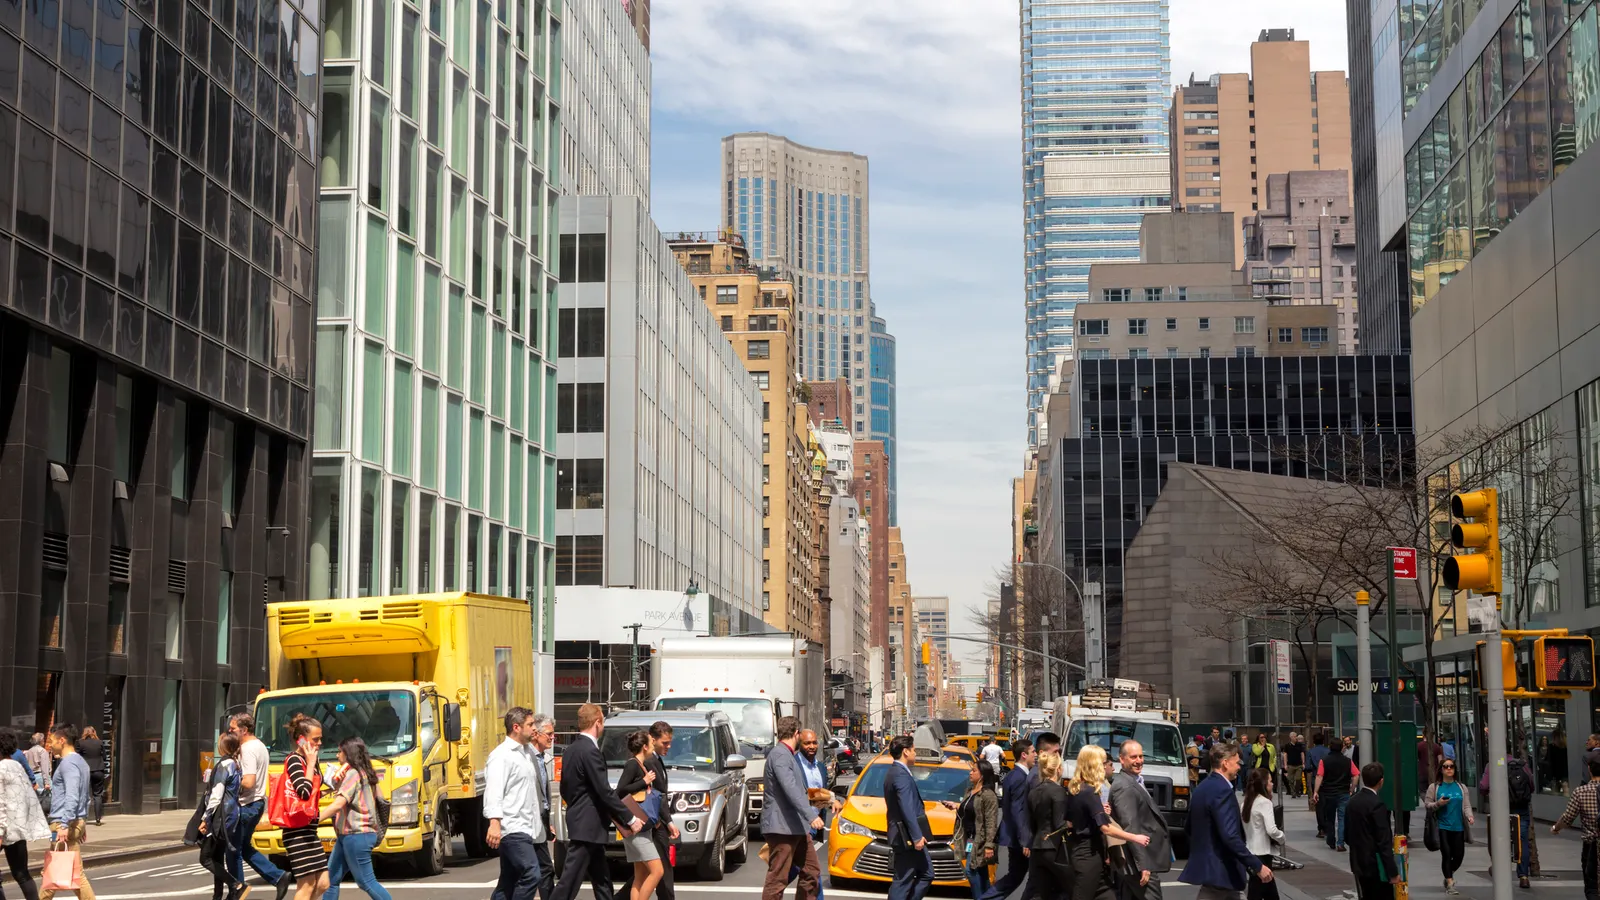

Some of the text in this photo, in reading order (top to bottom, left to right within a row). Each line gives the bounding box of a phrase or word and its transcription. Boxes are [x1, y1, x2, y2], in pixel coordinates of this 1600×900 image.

[644, 610, 702, 623] PARK AVENUE
[1337, 680, 1379, 693] Suby
